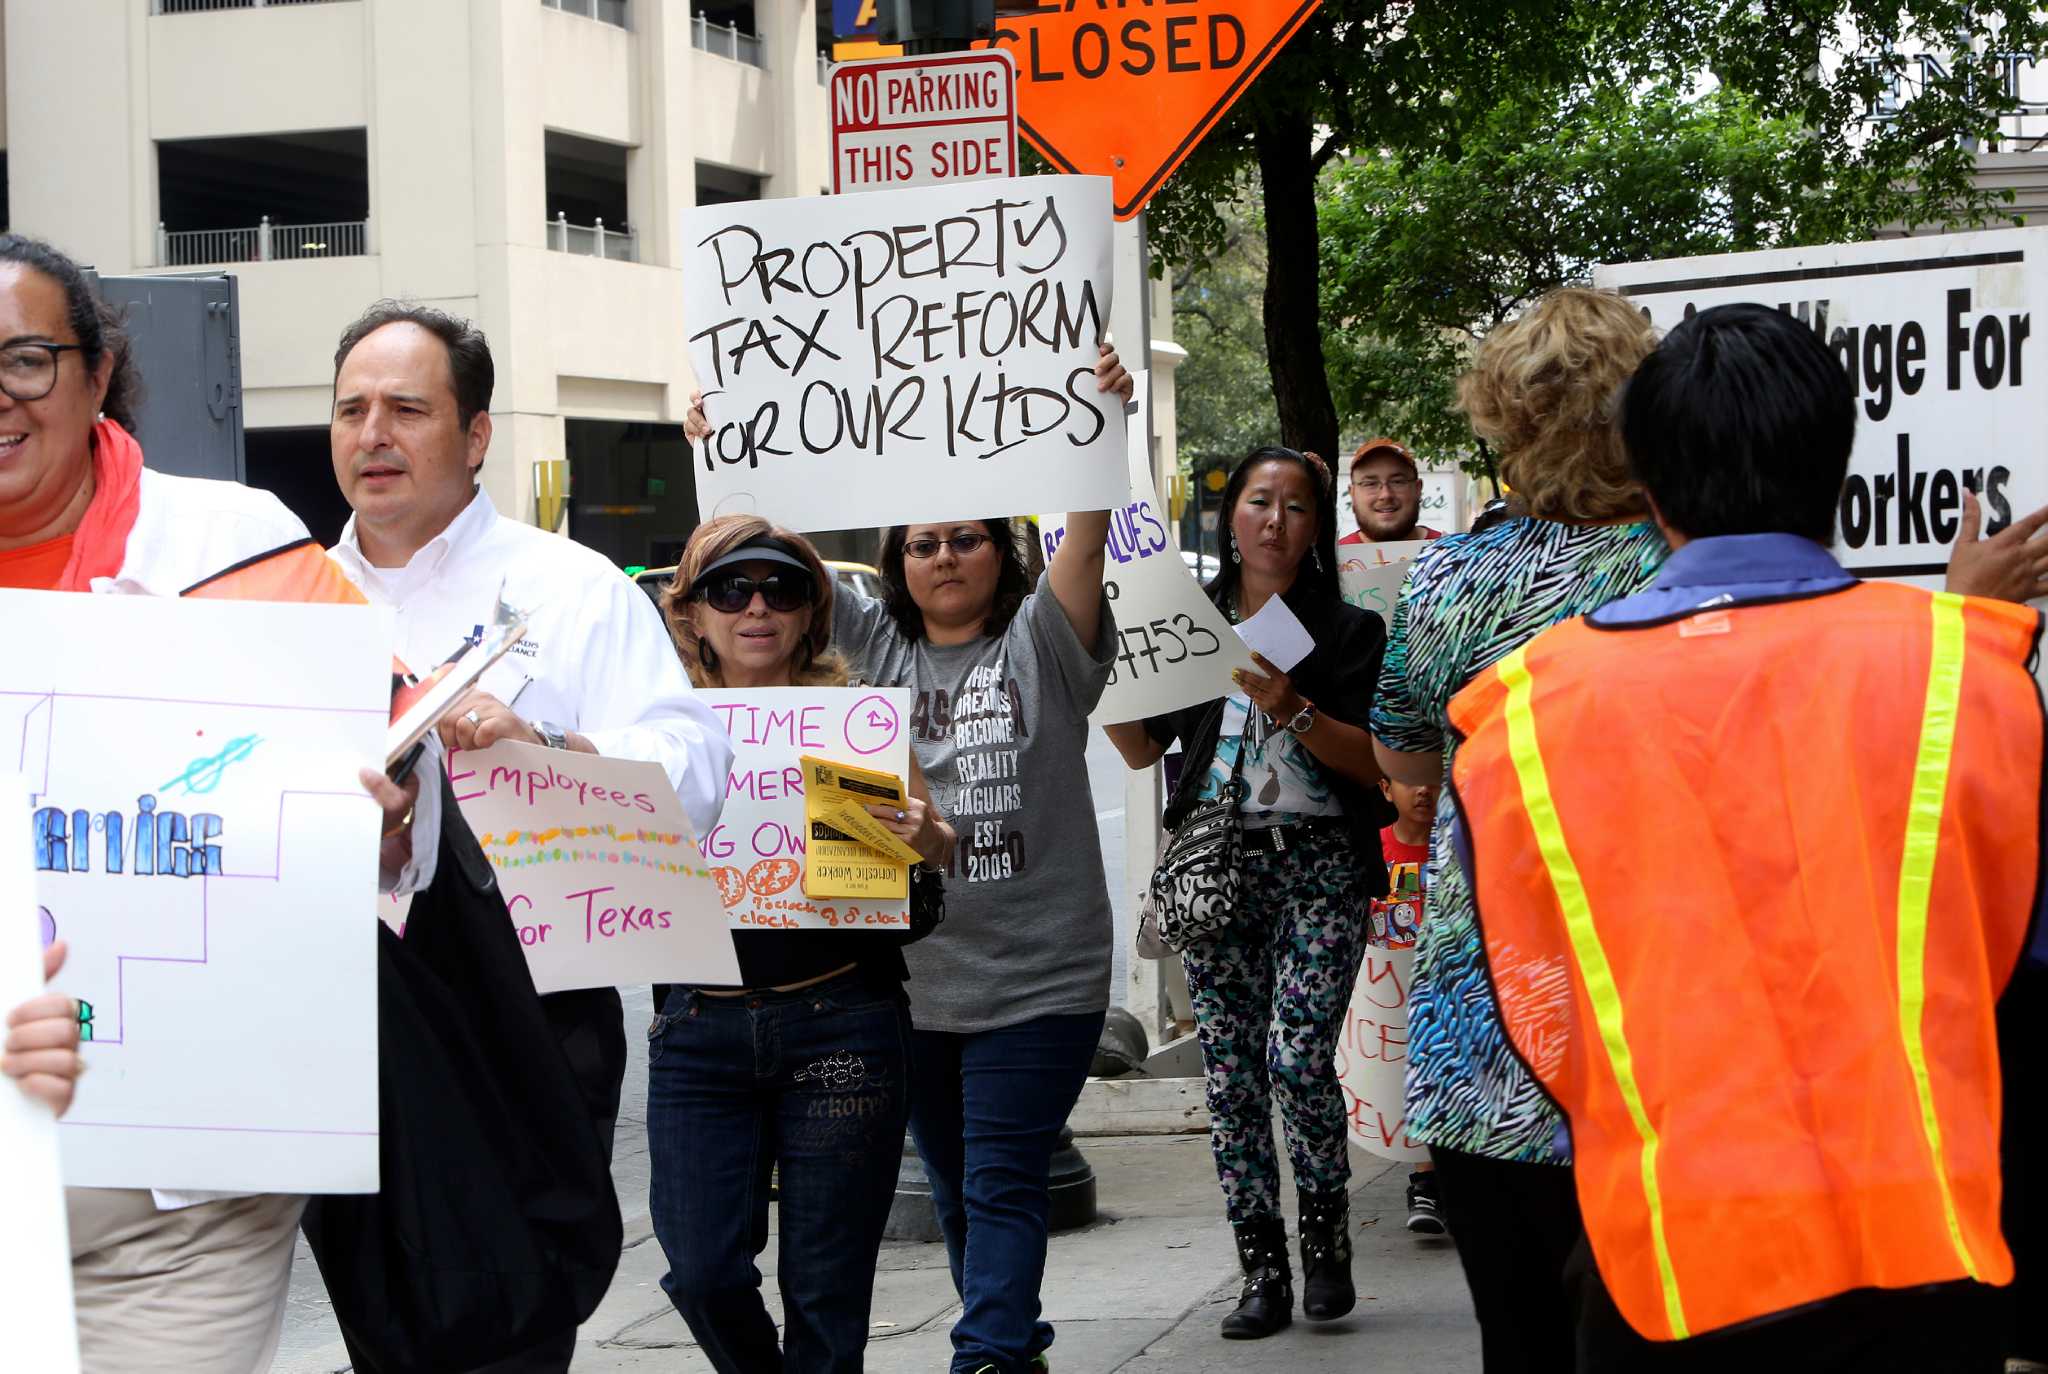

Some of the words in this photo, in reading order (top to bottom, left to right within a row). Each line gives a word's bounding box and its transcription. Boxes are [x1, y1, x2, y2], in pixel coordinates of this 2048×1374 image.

[990, 14, 1245, 83] CLOSED
[836, 75, 876, 126] NO
[888, 70, 998, 115] PARKING
[845, 145, 914, 184] THIS
[931, 138, 1001, 178] SIDE
[689, 309, 841, 388] TAX
[872, 279, 1105, 379] REFORM
[1947, 288, 2030, 391] For
[799, 380, 926, 456] OUR
[1841, 433, 2011, 549] orkers
[1106, 613, 1220, 686] 7753
[712, 704, 826, 748] TIME
[956, 717, 1014, 749] BECOME
[448, 747, 656, 813] Employees
[956, 750, 1018, 783] REALITY
[967, 852, 1012, 883] 2009
[565, 886, 672, 943] Texas
